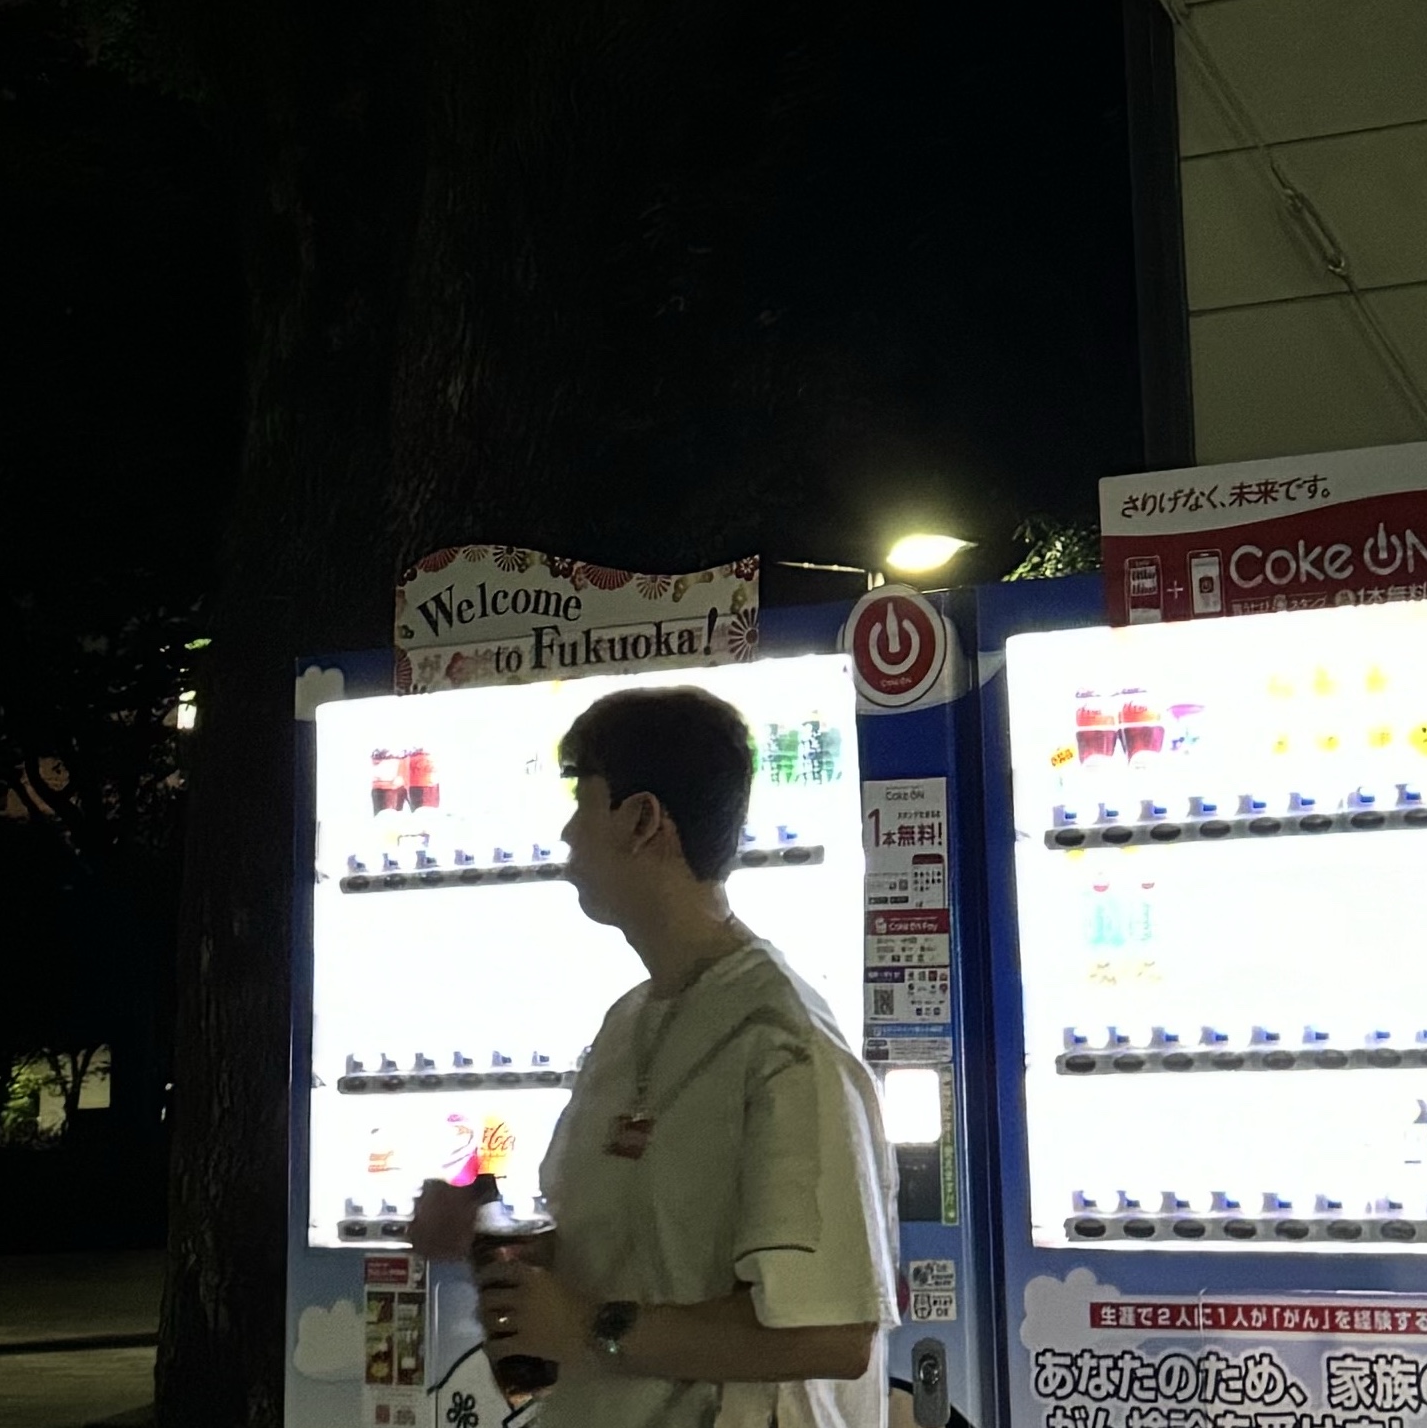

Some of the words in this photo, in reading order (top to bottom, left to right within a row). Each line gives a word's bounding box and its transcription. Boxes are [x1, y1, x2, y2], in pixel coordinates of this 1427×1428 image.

[1121, 474, 1331, 518] さりげなく、未来です。
[1229, 539, 1354, 588] Coke
[417, 582, 582, 638] Welcome
[494, 645, 521, 673] to
[532, 606, 718, 671] Fukuoka!
[868, 808, 942, 848] 1本無料!
